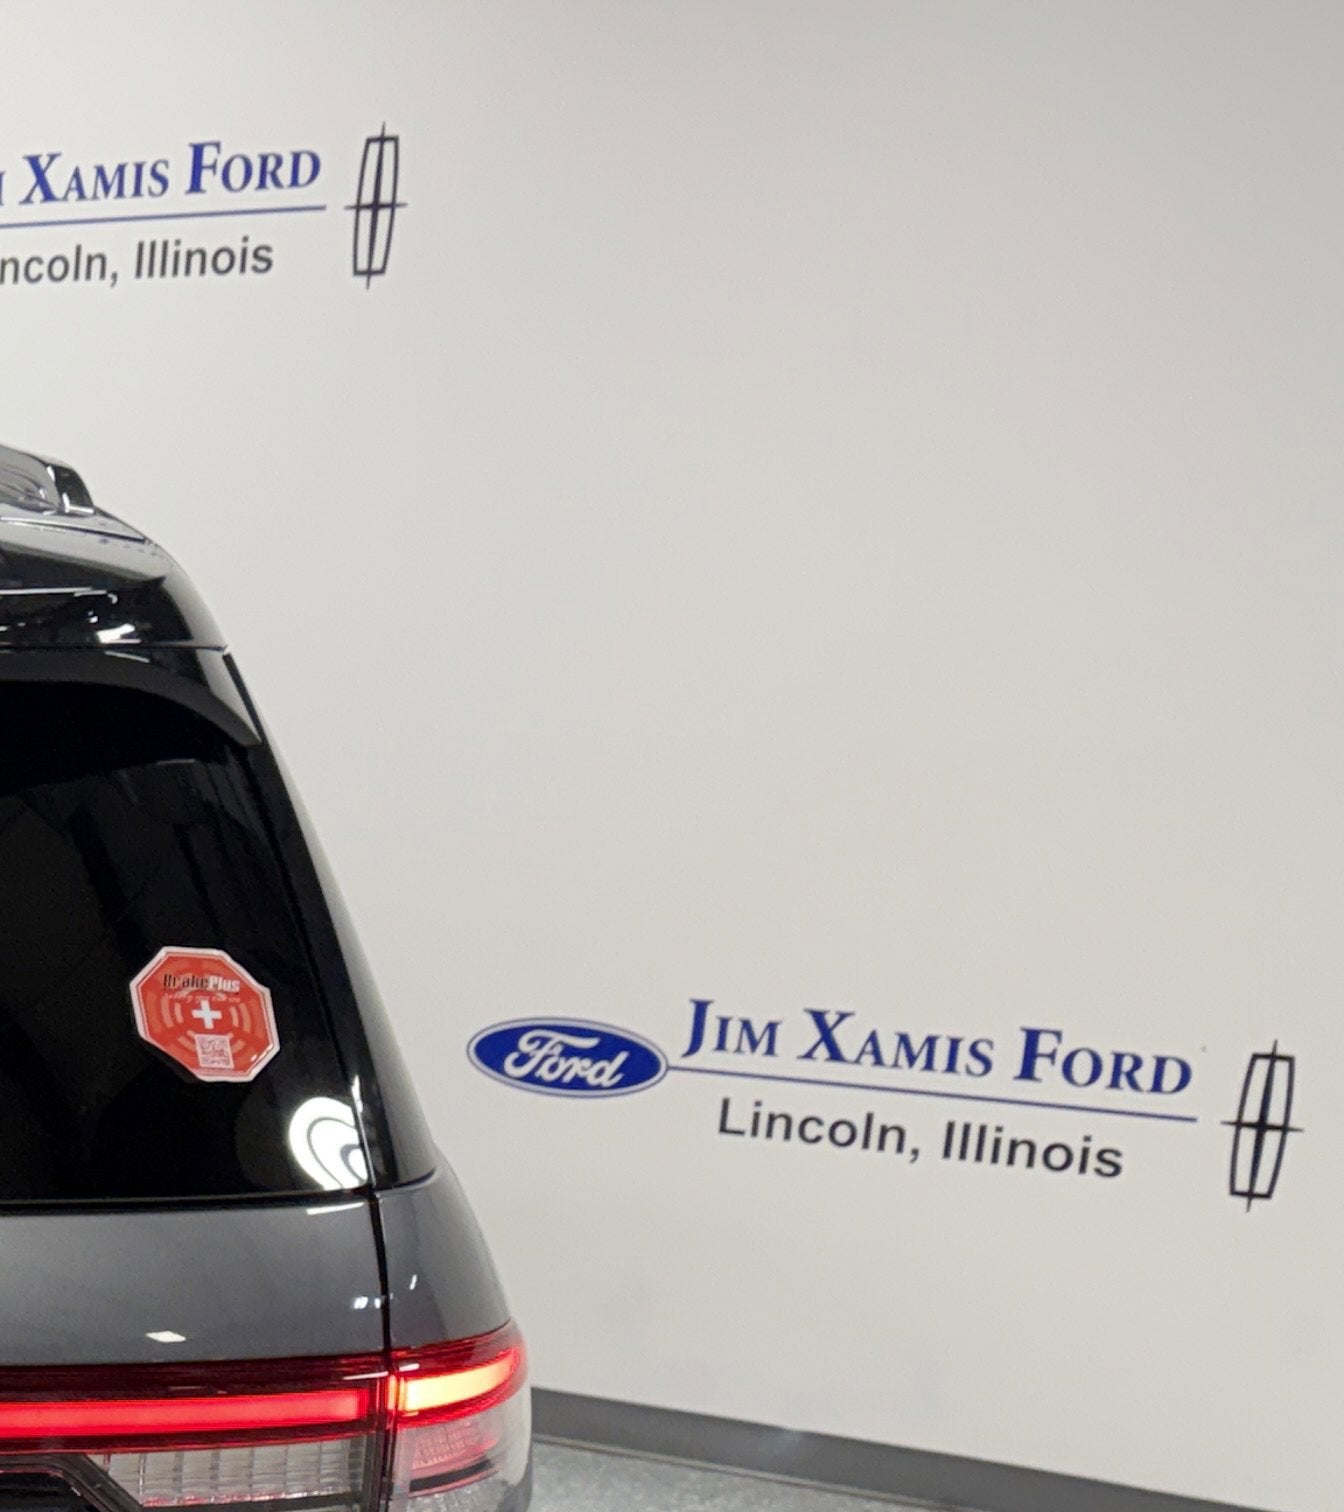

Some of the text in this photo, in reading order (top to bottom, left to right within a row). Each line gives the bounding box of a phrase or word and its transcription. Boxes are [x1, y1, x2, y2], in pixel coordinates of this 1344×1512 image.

[18, 152, 171, 204] XAMIS
[185, 140, 321, 195] FORD
[135, 236, 274, 280] Illinois
[503, 1033, 628, 1090] Ford
[681, 998, 1193, 1096] JIM XAMIS FORD
[717, 1098, 1123, 1179] Lincoln, Illinois
